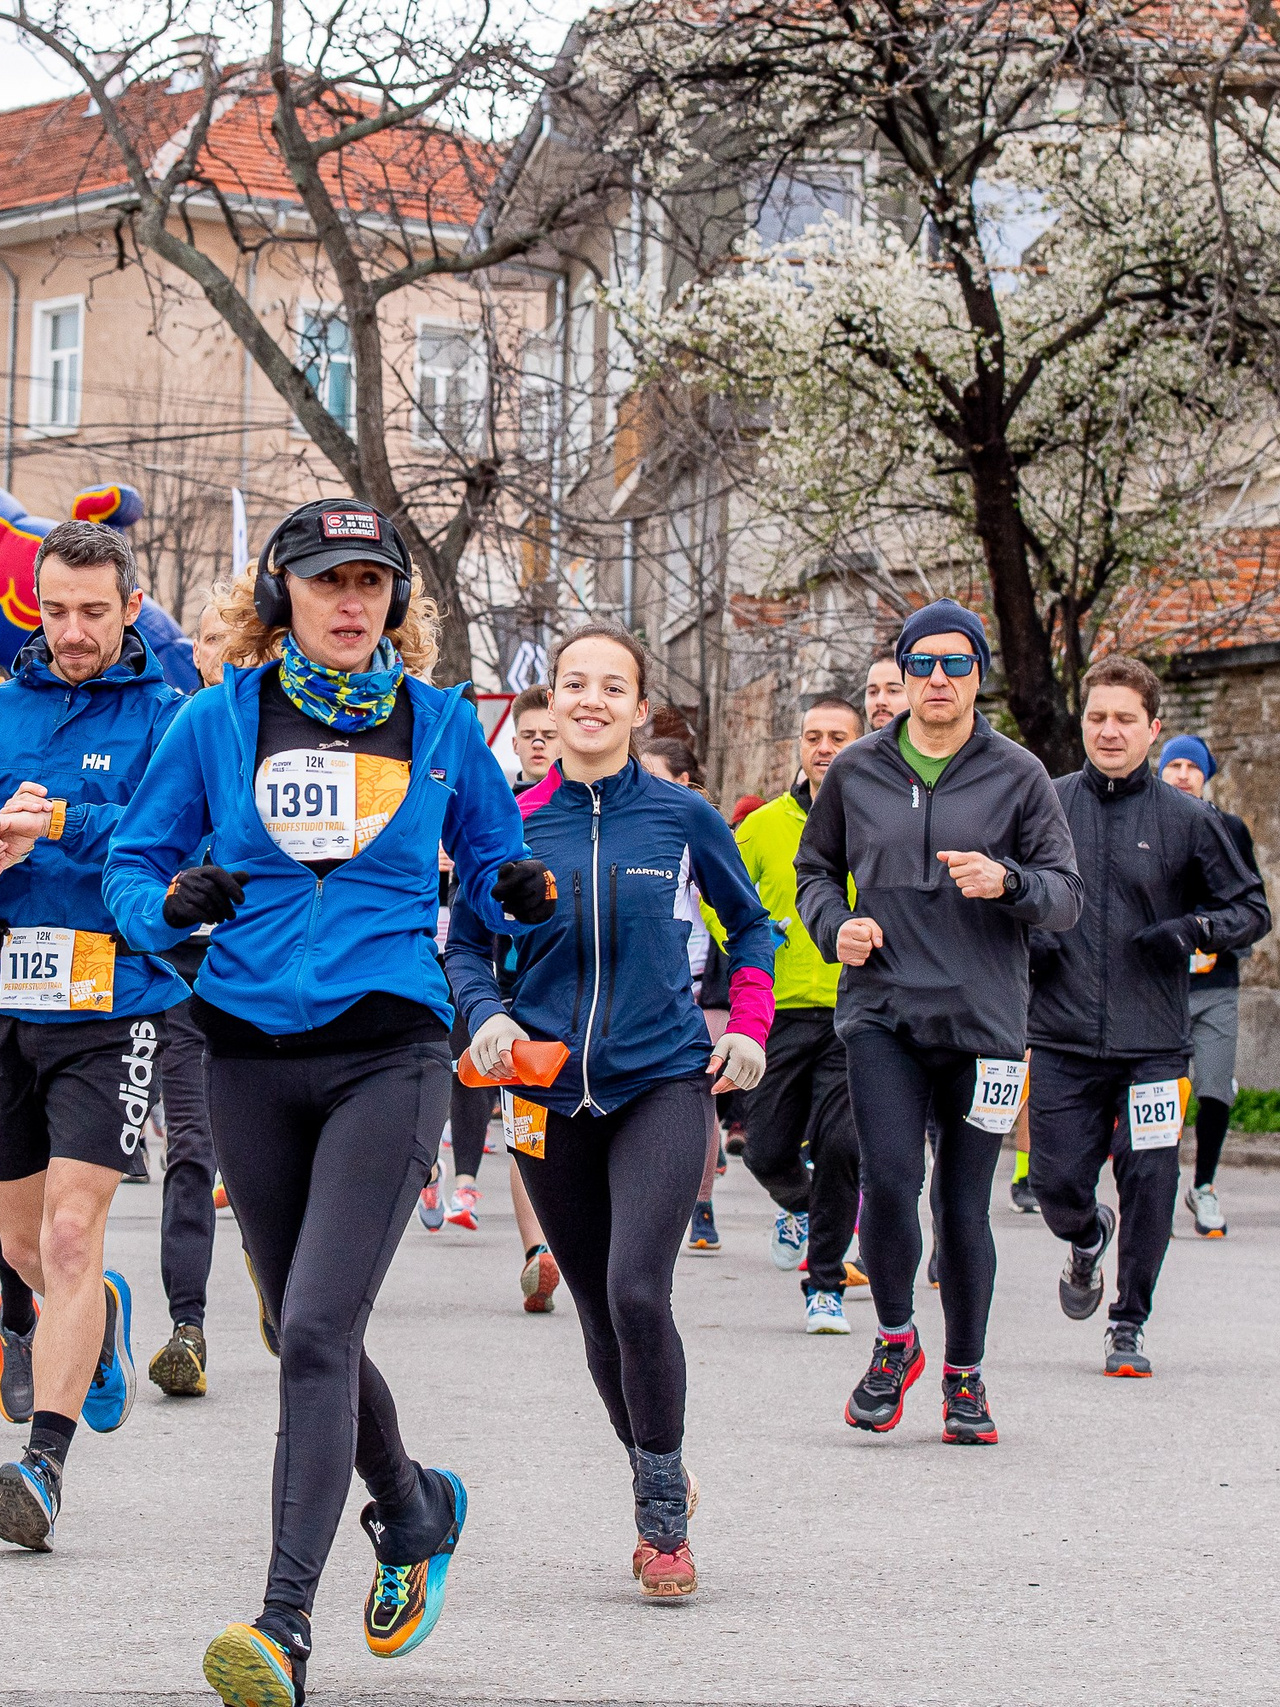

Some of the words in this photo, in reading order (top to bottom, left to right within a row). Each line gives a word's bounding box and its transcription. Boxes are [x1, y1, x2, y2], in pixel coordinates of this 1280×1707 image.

[350, 528, 376, 536] CONTACT
[82, 753, 111, 771] HH
[306, 756, 324, 768] 12K
[267, 782, 338, 818] 1391
[325, 821, 346, 831] TRAIL
[625, 868, 665, 877] MARTINI
[36, 931, 51, 941] 12K
[9, 952, 59, 980] 1125
[1006, 1065, 1018, 1074] 12K
[118, 1021, 158, 1156] adidas
[982, 1081, 1019, 1106] 1321
[1133, 1100, 1175, 1125] 1287
